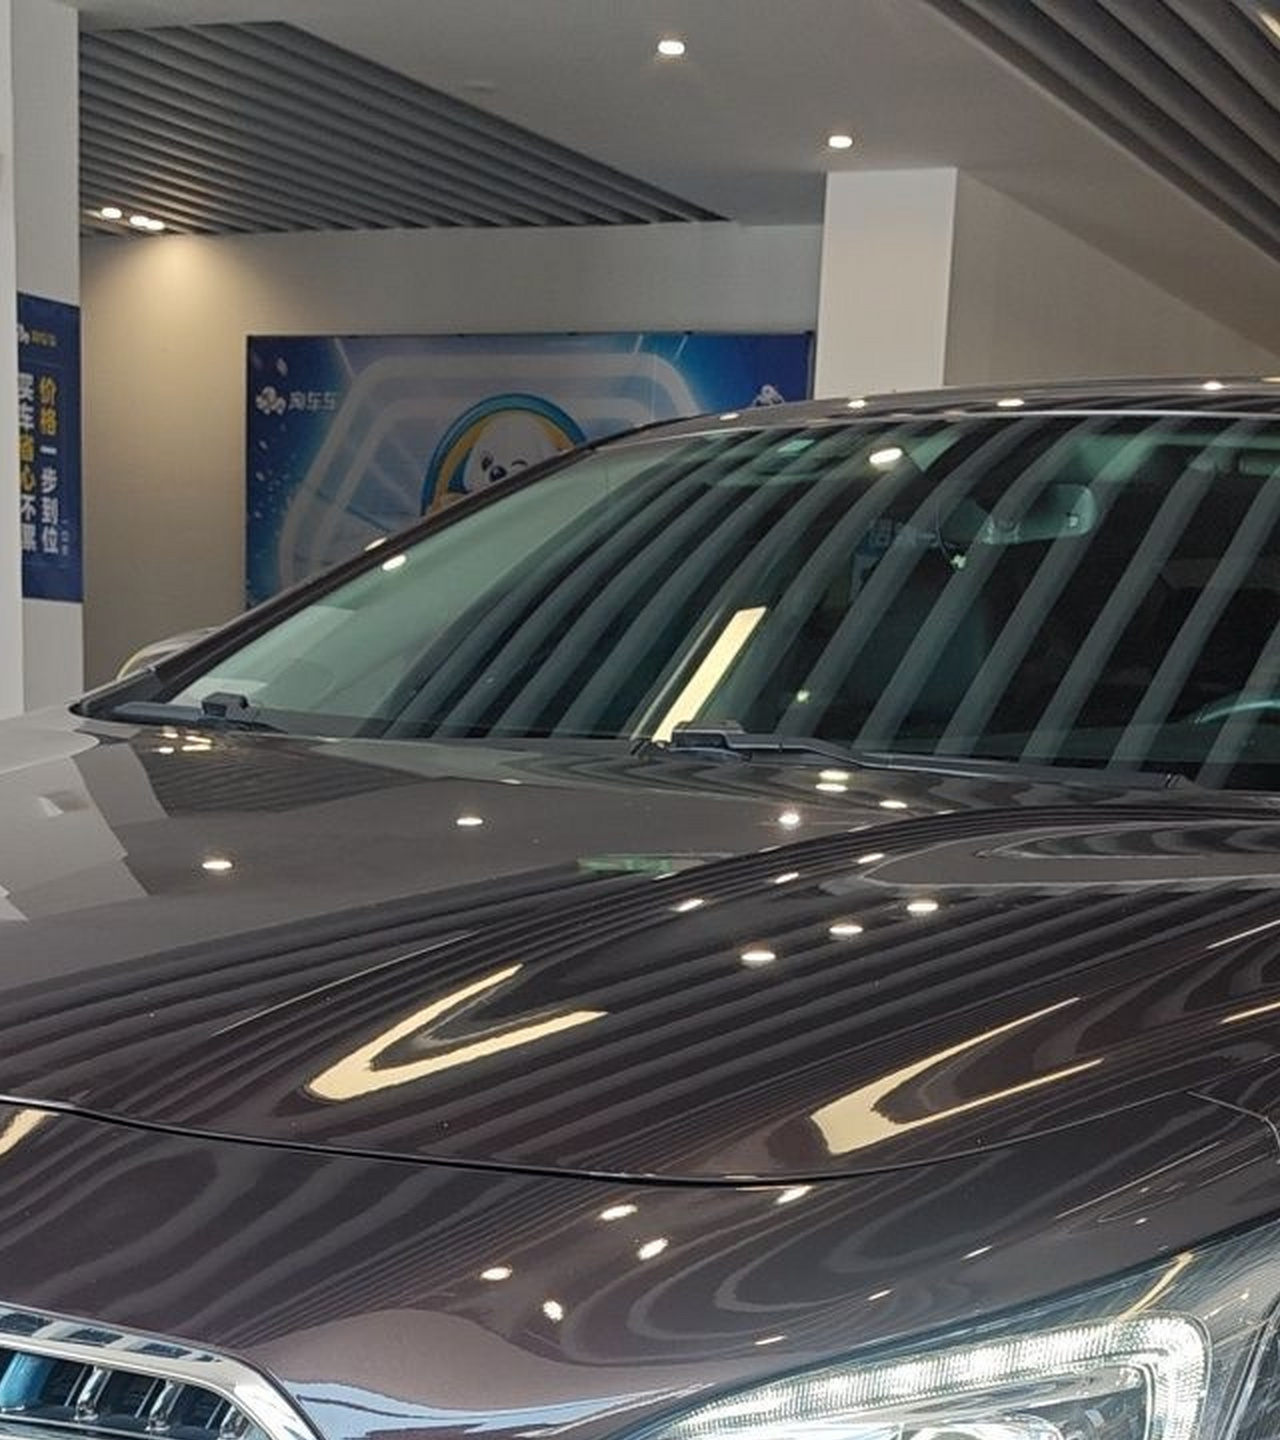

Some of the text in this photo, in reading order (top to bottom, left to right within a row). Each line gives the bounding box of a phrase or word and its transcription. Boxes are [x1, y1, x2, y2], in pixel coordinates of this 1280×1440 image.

[40, 375, 59, 554] 价格一步到位
